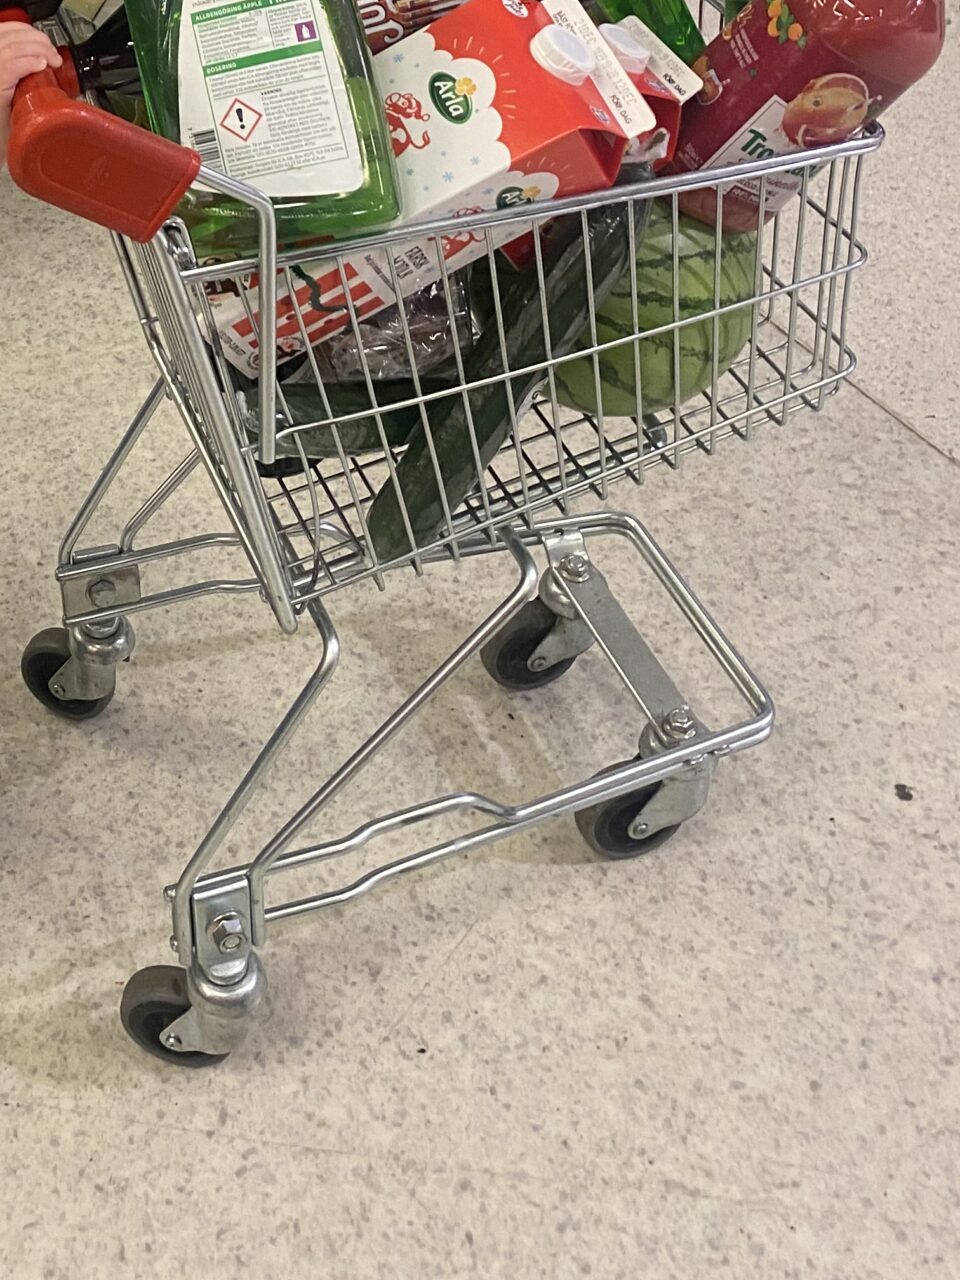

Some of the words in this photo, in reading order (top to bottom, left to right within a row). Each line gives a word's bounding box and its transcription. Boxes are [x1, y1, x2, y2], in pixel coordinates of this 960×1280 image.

[195, 6, 242, 21] ALLRENGÖRING
[243, 0, 263, 10] ÄPPLE
[206, 62, 237, 74] DOSERING
[434, 81, 464, 117] Arla
